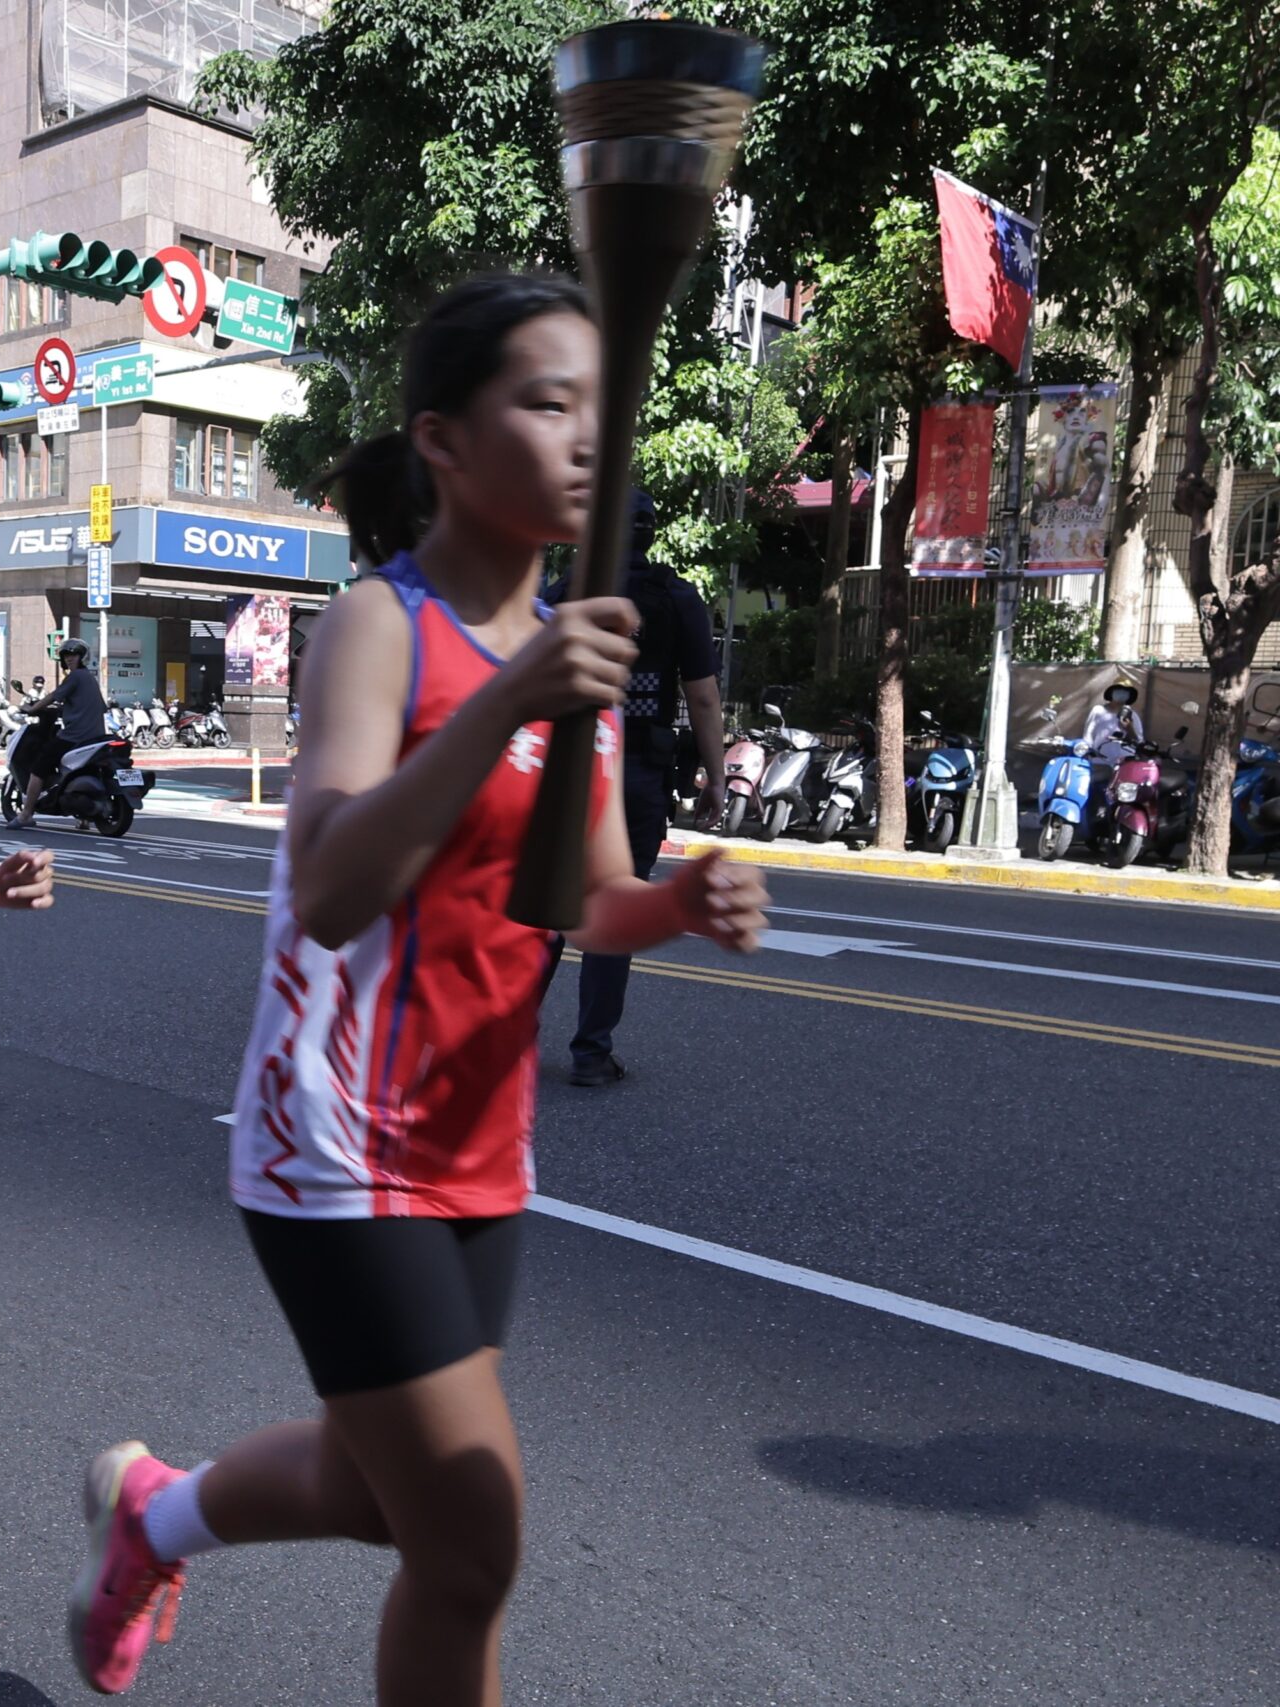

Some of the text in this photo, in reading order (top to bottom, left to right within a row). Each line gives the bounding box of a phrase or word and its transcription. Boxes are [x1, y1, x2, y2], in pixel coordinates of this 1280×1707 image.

[246, 294, 289, 326] 信二路
[241, 322, 255, 336] Xin
[256, 326, 273, 340] 2nd
[102, 487, 110, 539] 車不讓人
[9, 527, 73, 555] ASUS
[184, 526, 285, 562] SONY
